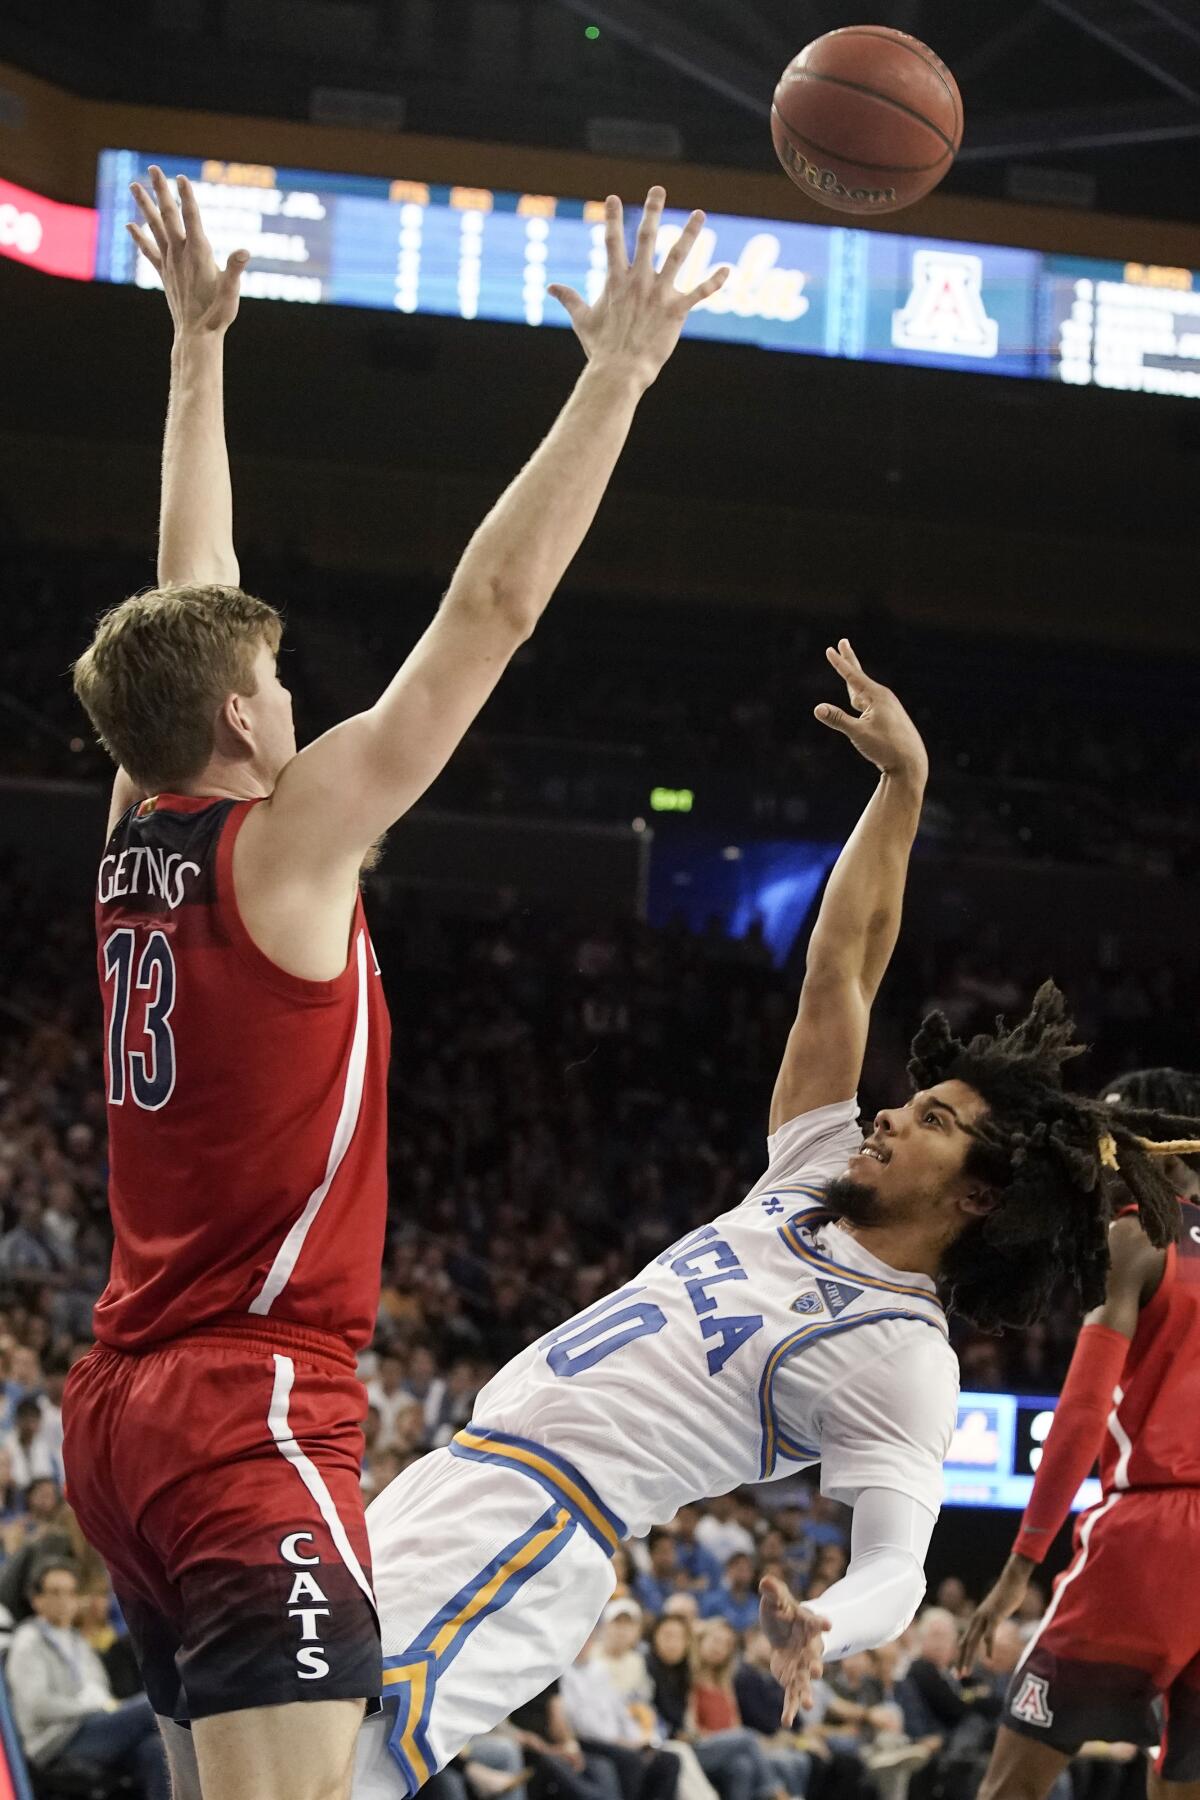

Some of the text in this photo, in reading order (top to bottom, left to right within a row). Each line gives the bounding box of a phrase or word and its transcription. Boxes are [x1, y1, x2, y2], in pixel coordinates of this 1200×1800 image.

[103, 928, 176, 1111] 13
[656, 1225, 764, 1377] UCLA
[825, 1282, 846, 1308] JRW
[280, 1532, 331, 1680] CATS
[1012, 1674, 1053, 1727] A
